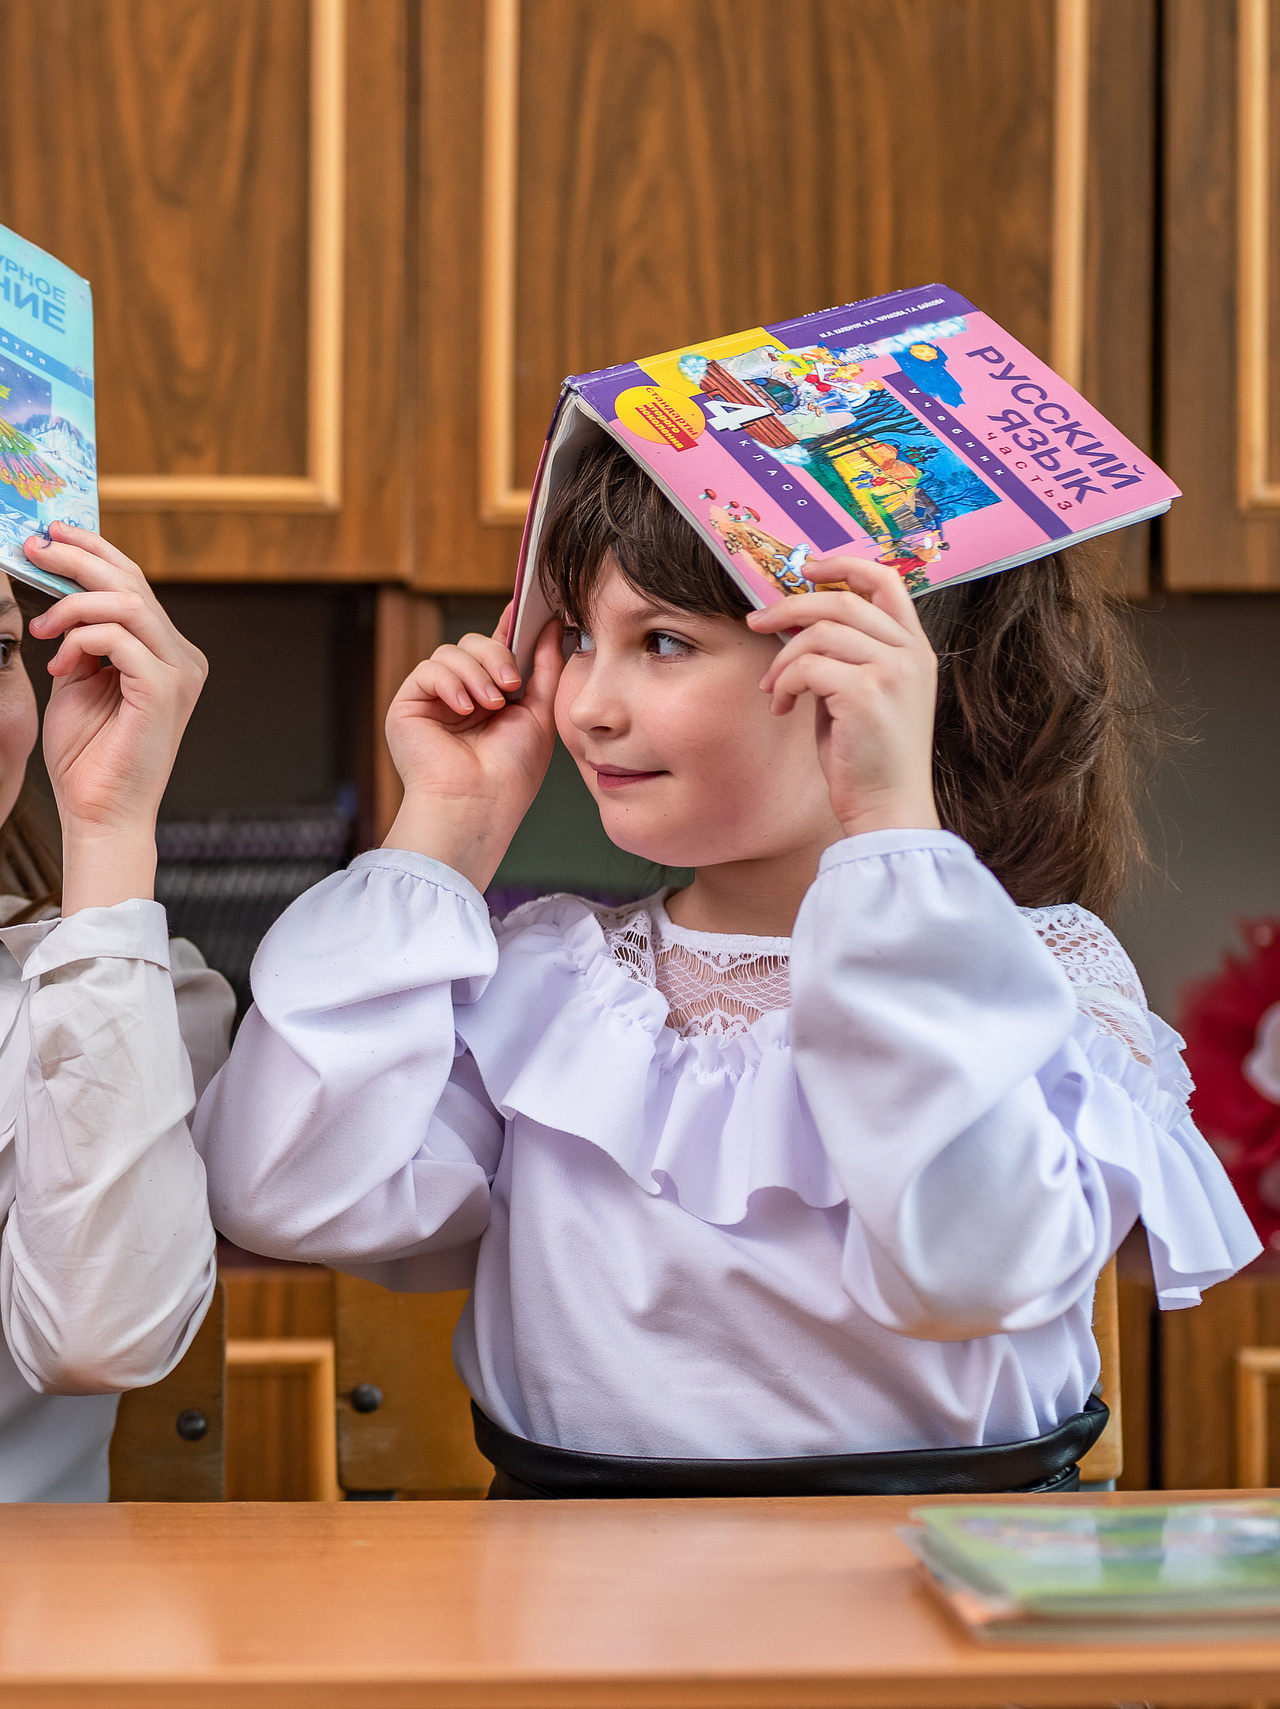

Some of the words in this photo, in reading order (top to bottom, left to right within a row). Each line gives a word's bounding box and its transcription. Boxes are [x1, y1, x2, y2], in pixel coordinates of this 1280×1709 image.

[639, 405, 685, 450] поколения
[646, 387, 699, 436] стандарты
[648, 403, 681, 435] второго
[703, 400, 775, 432] 4
[965, 345, 1145, 490] РУССКИЙ
[986, 408, 1108, 505] ЯЗЫК
